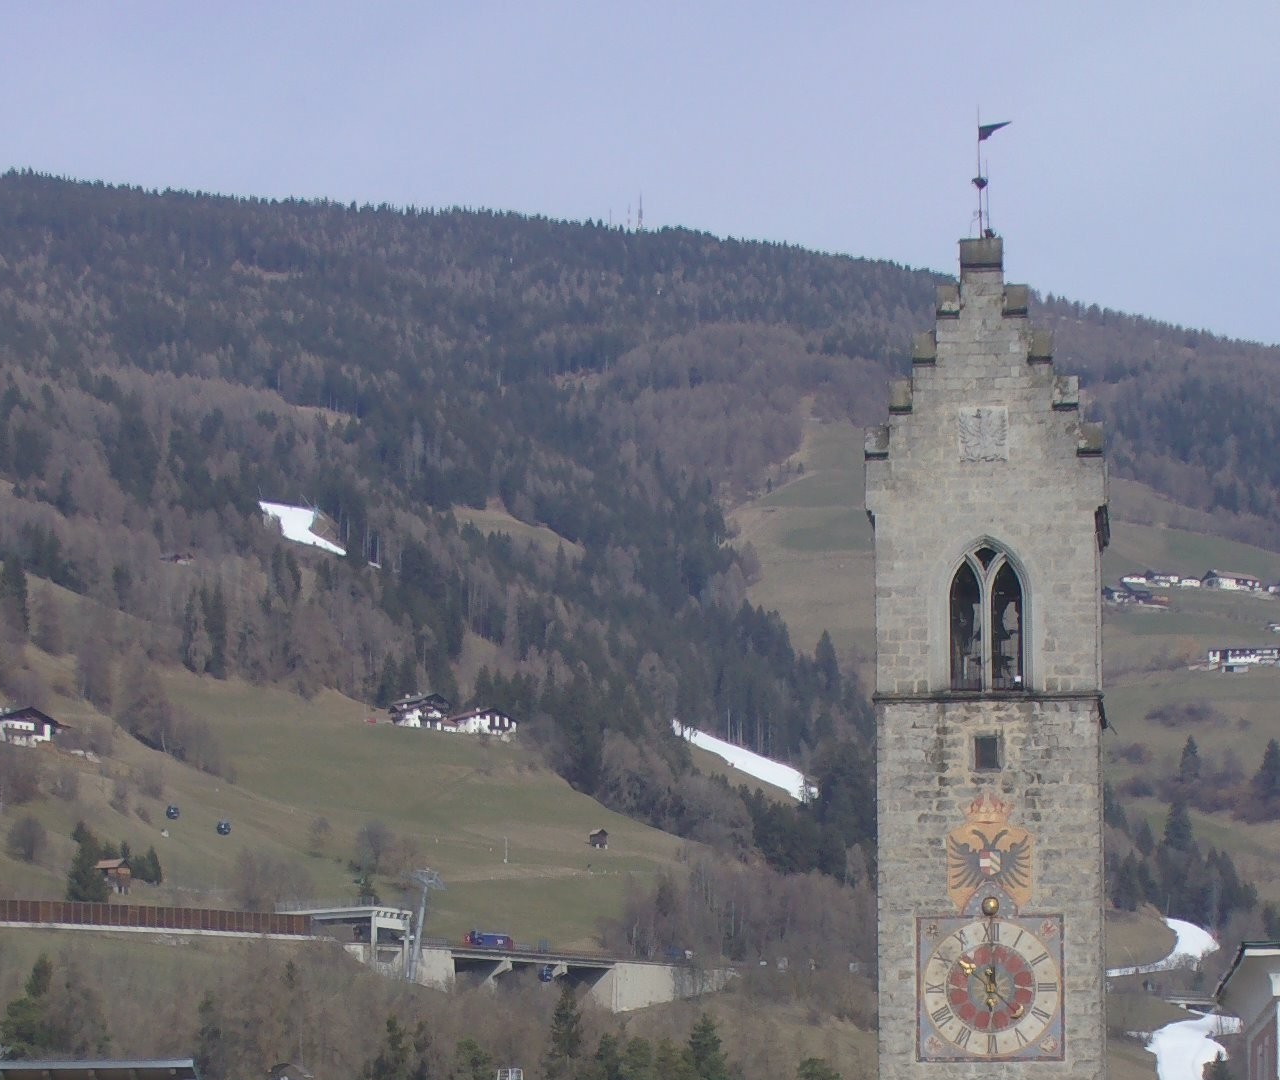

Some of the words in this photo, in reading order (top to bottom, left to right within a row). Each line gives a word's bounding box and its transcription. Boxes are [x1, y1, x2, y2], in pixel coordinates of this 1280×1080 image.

[1013, 929, 1023, 948] I
[1030, 951, 1048, 966] II
[926, 982, 945, 993] IX
[1037, 982, 1057, 993] III
[986, 1034, 999, 1054] VI
[1014, 1027, 1028, 1047] V
